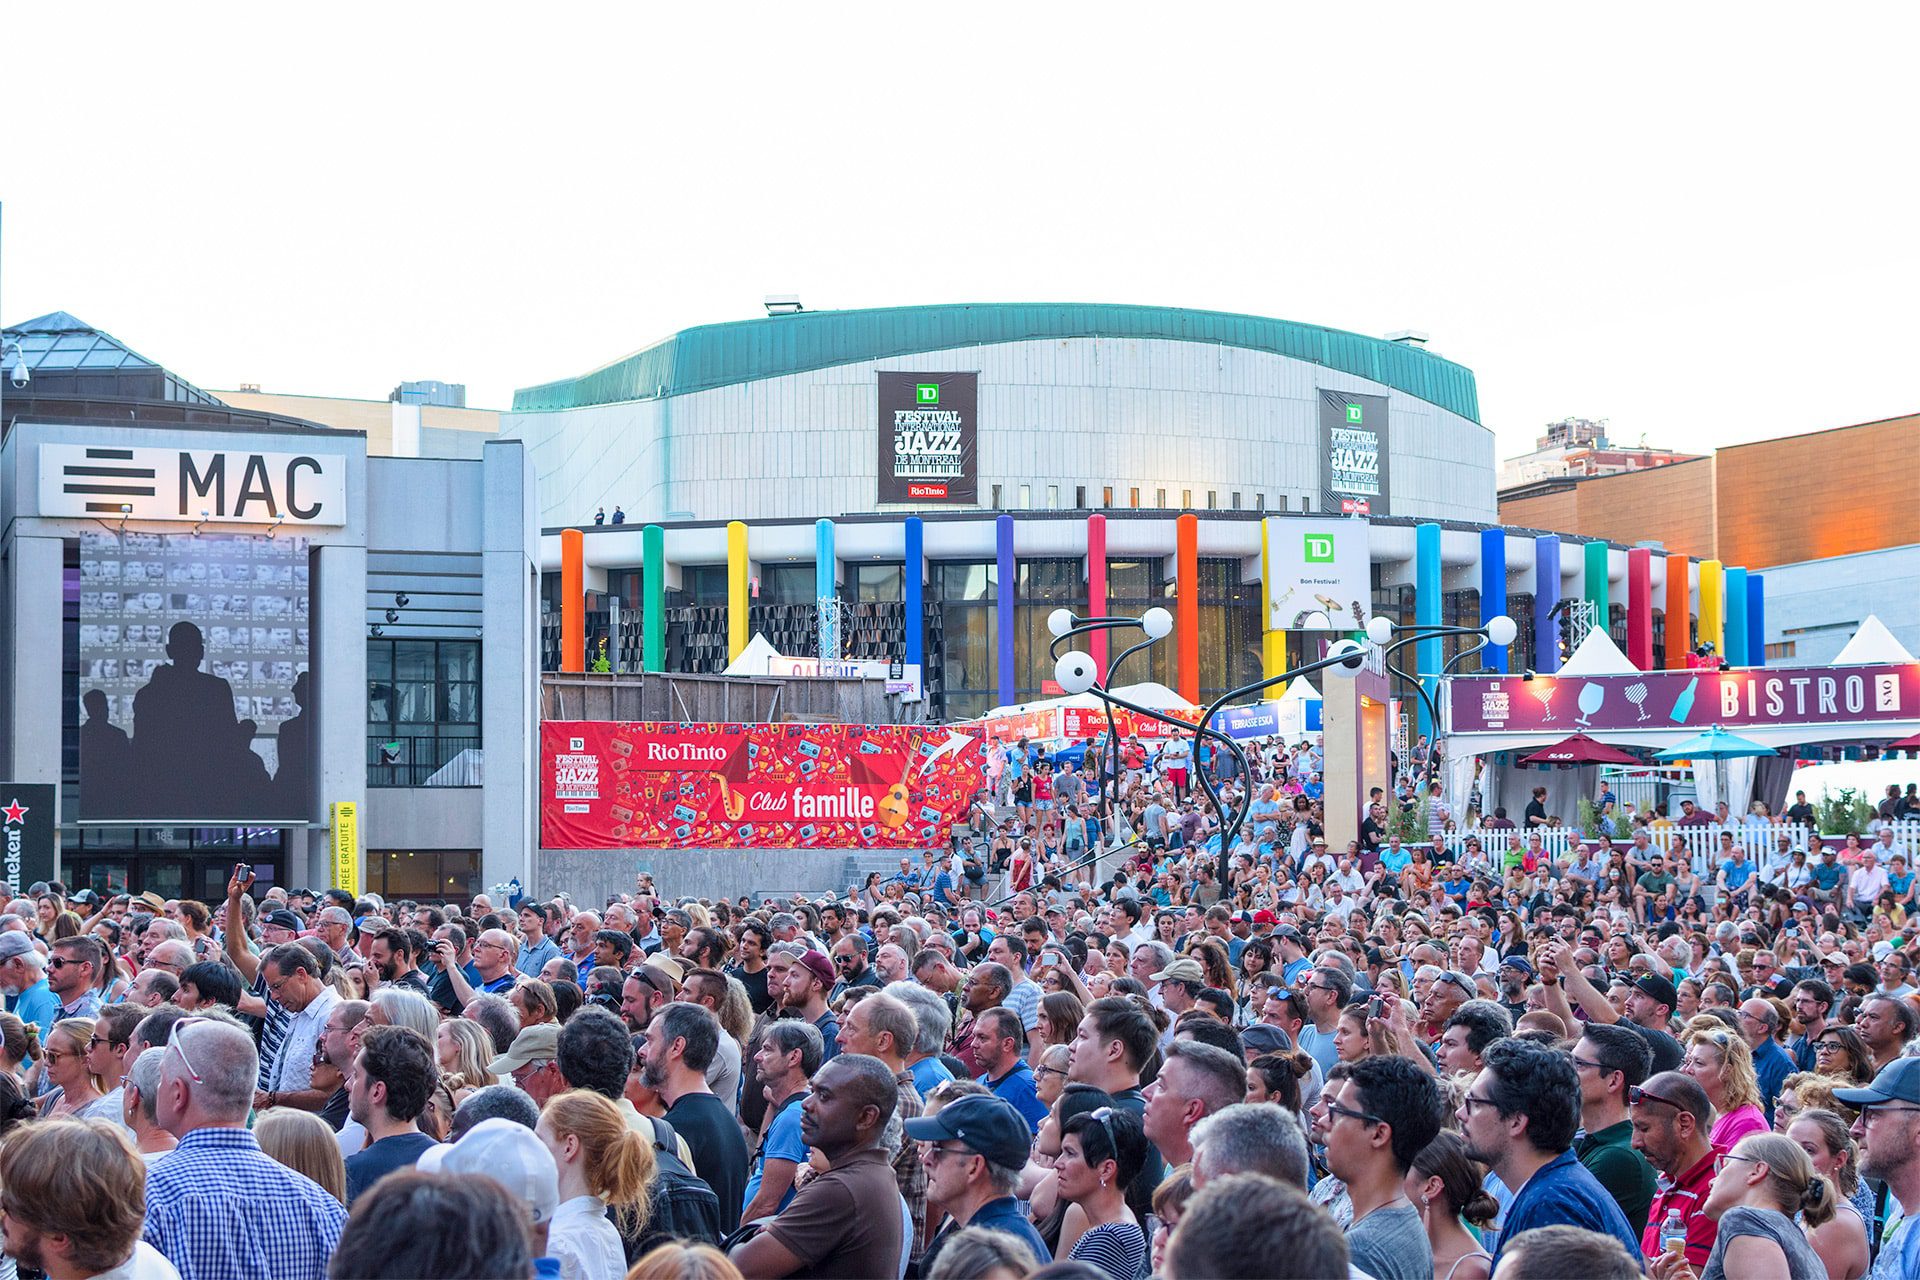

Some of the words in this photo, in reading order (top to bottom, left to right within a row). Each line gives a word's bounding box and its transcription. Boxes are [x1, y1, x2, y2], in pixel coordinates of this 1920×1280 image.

[919, 387, 937, 400] TD
[894, 410, 962, 423] FESTIVAL
[1348, 407, 1361, 420] TD
[894, 422, 962, 432] INTERNATIONAL
[894, 431, 962, 455] JAZZ
[1330, 427, 1378, 445] FESTIVAL
[895, 454, 908, 465] DE
[1331, 448, 1379, 475] JAZZ
[179, 452, 323, 520] MAC
[1306, 538, 1332, 558] TD
[1720, 674, 1864, 718] BISTRO
[1882, 680, 1893, 706] SAQ
[1139, 722, 1158, 733] Club
[1231, 717, 1258, 730] TERRASSE
[1258, 715, 1274, 727] ESKA
[555, 754, 599, 764] FESTIVAL
[555, 768, 599, 785] JAZZ
[749, 791, 788, 811] Club
[793, 787, 874, 818] famille
[154, 831, 174, 841] 185
[340, 821, 351, 866] GRATUITE
